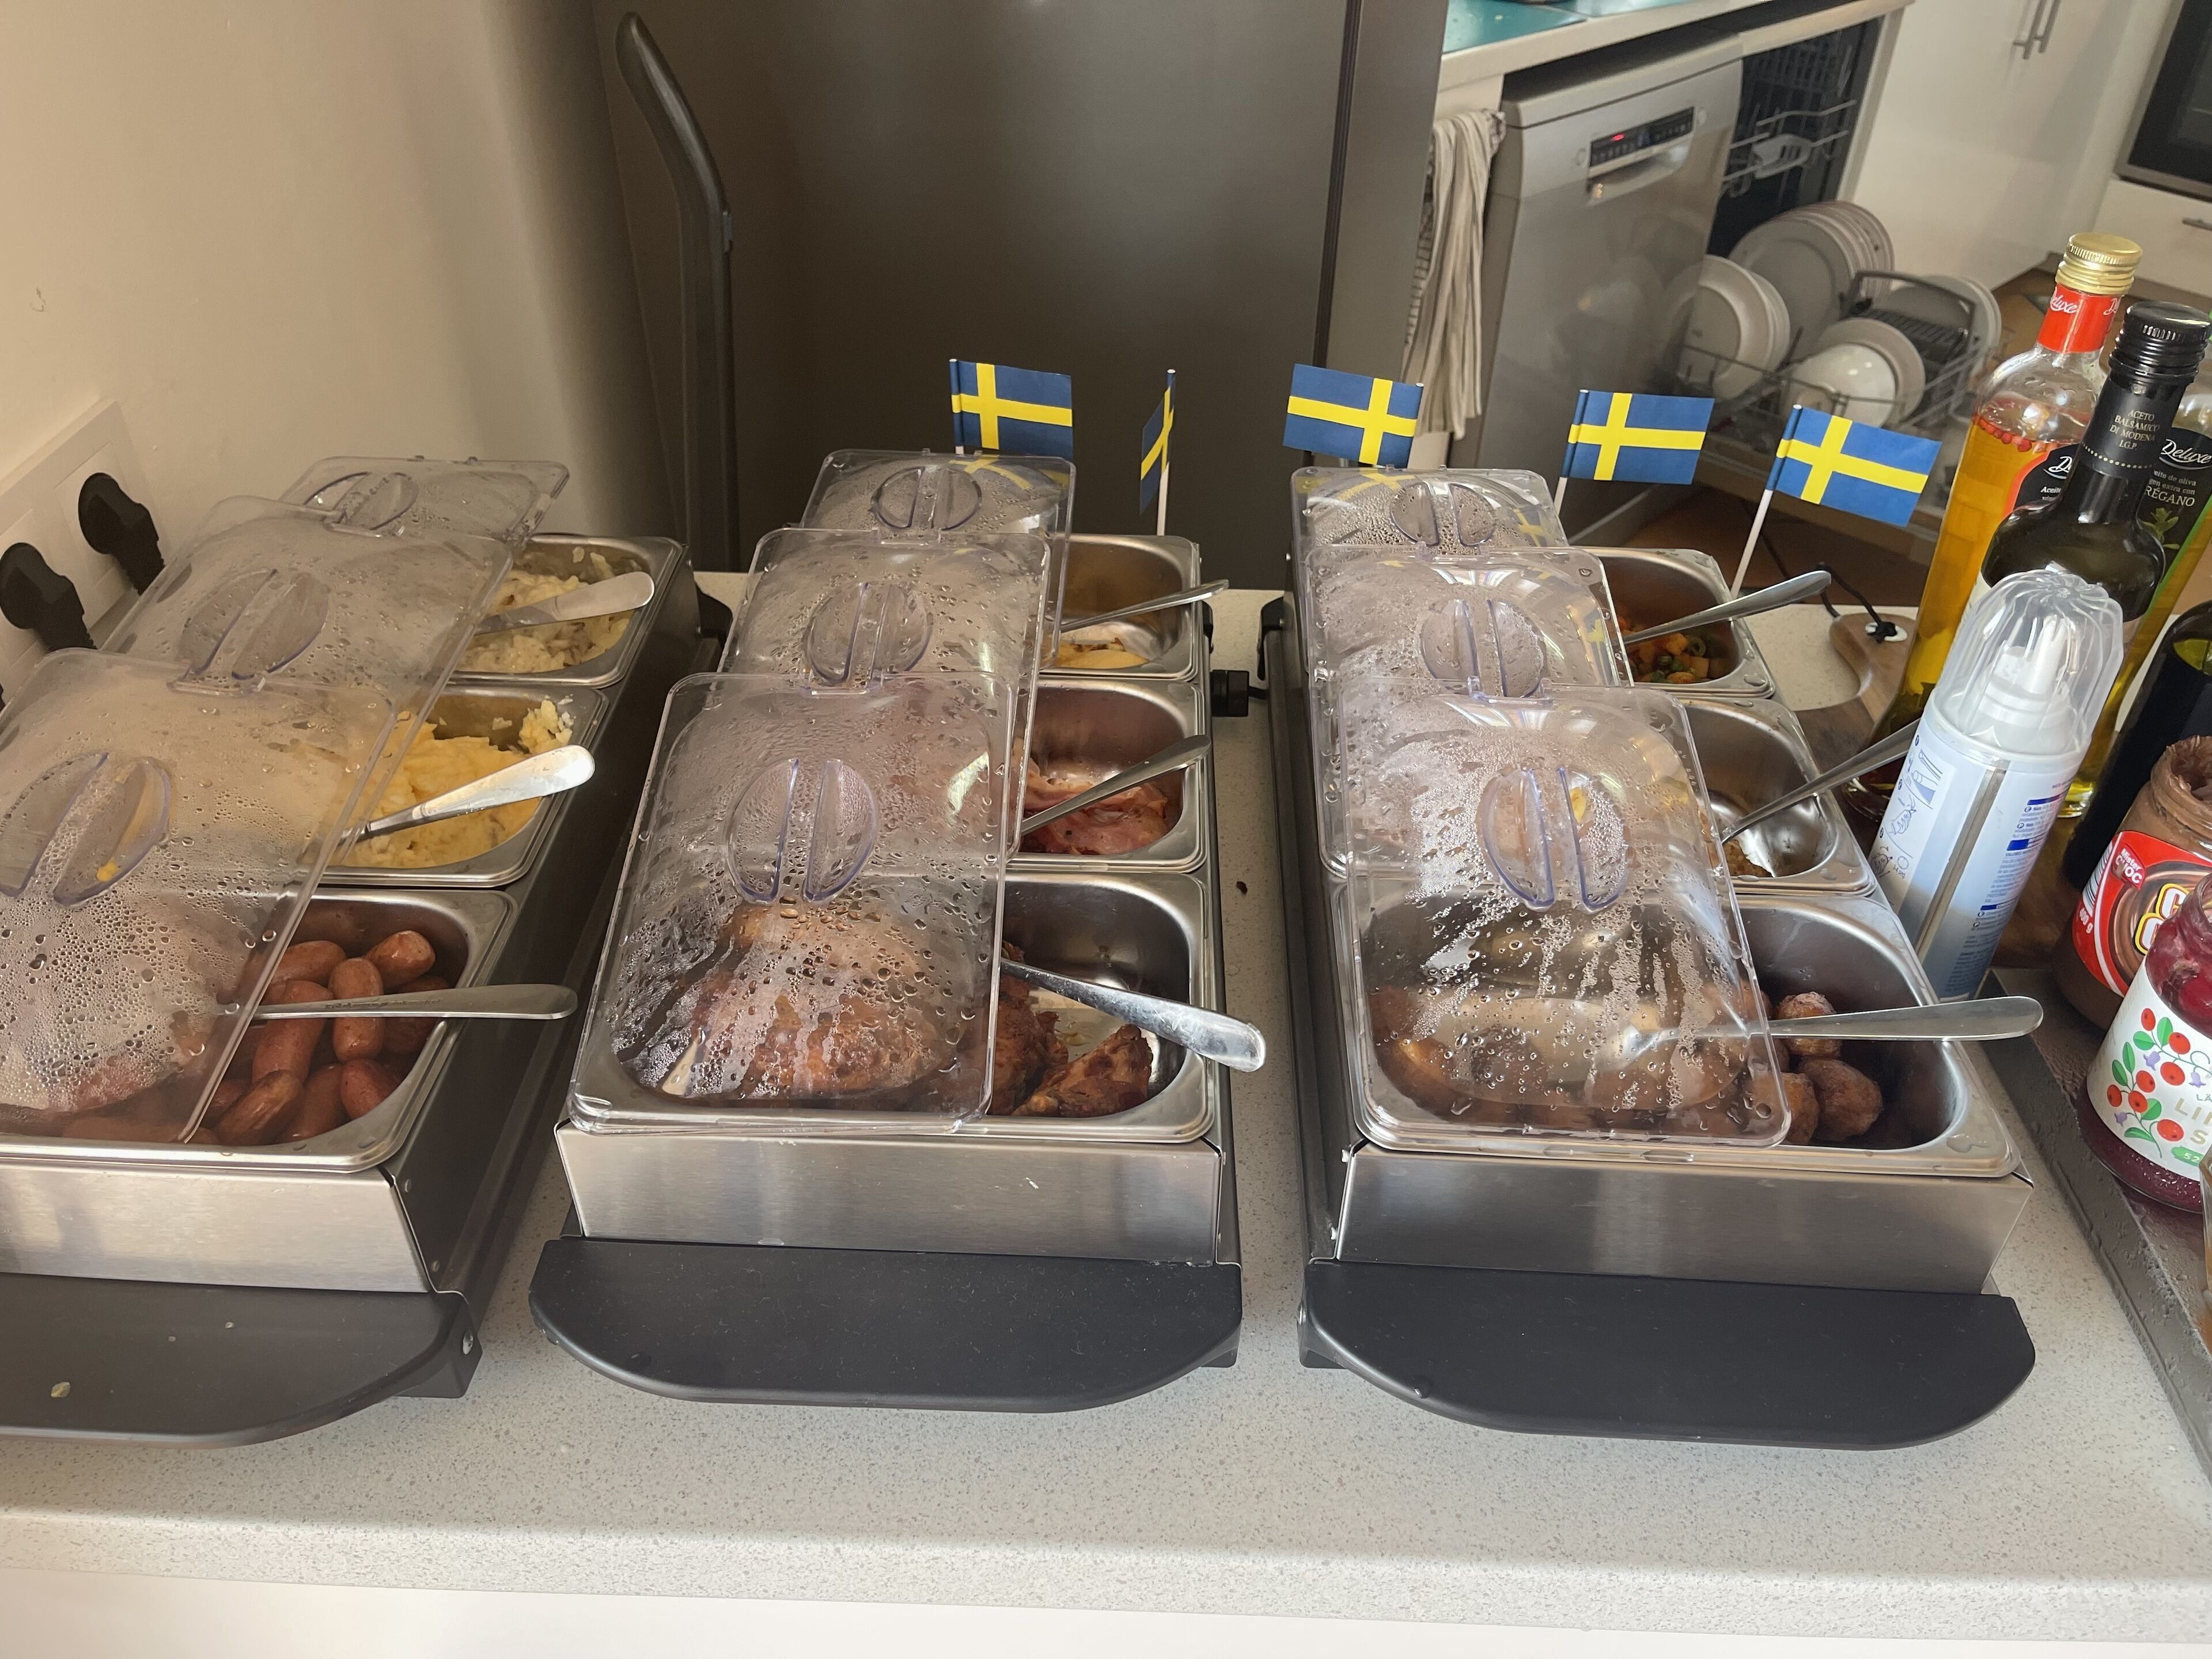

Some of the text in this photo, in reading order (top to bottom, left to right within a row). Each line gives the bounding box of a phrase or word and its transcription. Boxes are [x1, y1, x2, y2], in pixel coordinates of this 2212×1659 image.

[2115, 415, 2160, 431] BALSAMICO
[2127, 410, 2154, 421] ACETO
[2109, 424, 2155, 441] DI MODENA
[2161, 438, 2211, 464] Deluxe
[2162, 483, 2180, 492] extra
[2120, 848, 2142, 871] Mister
[2190, 1129, 2209, 1145] S
[2184, 1152, 2200, 1163] 52
